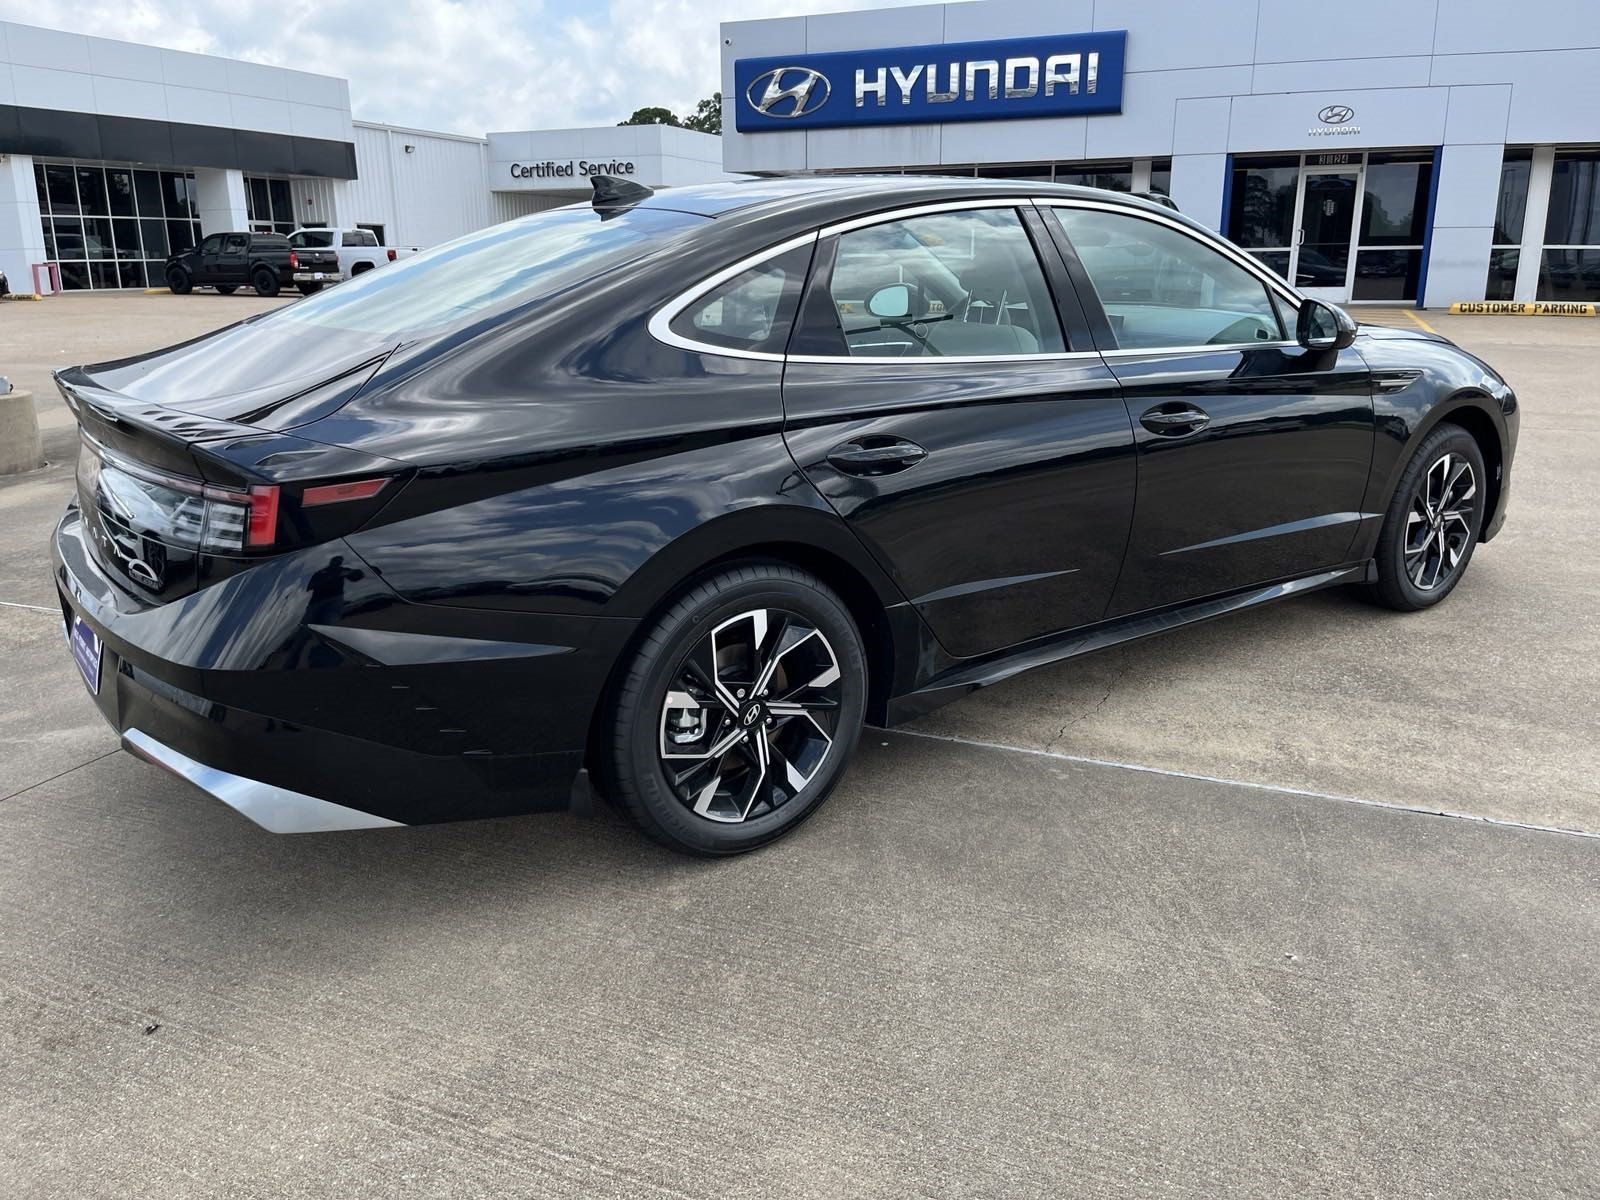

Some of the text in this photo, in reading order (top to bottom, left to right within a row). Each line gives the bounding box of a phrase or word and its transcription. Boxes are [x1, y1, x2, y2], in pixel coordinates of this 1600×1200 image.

[855, 52, 1100, 107] HYUNDAI
[1308, 126, 1361, 137] HYUNDAI
[510, 159, 634, 179] Certified Service
[1459, 303, 1588, 314] CUSTOMER PARKING
